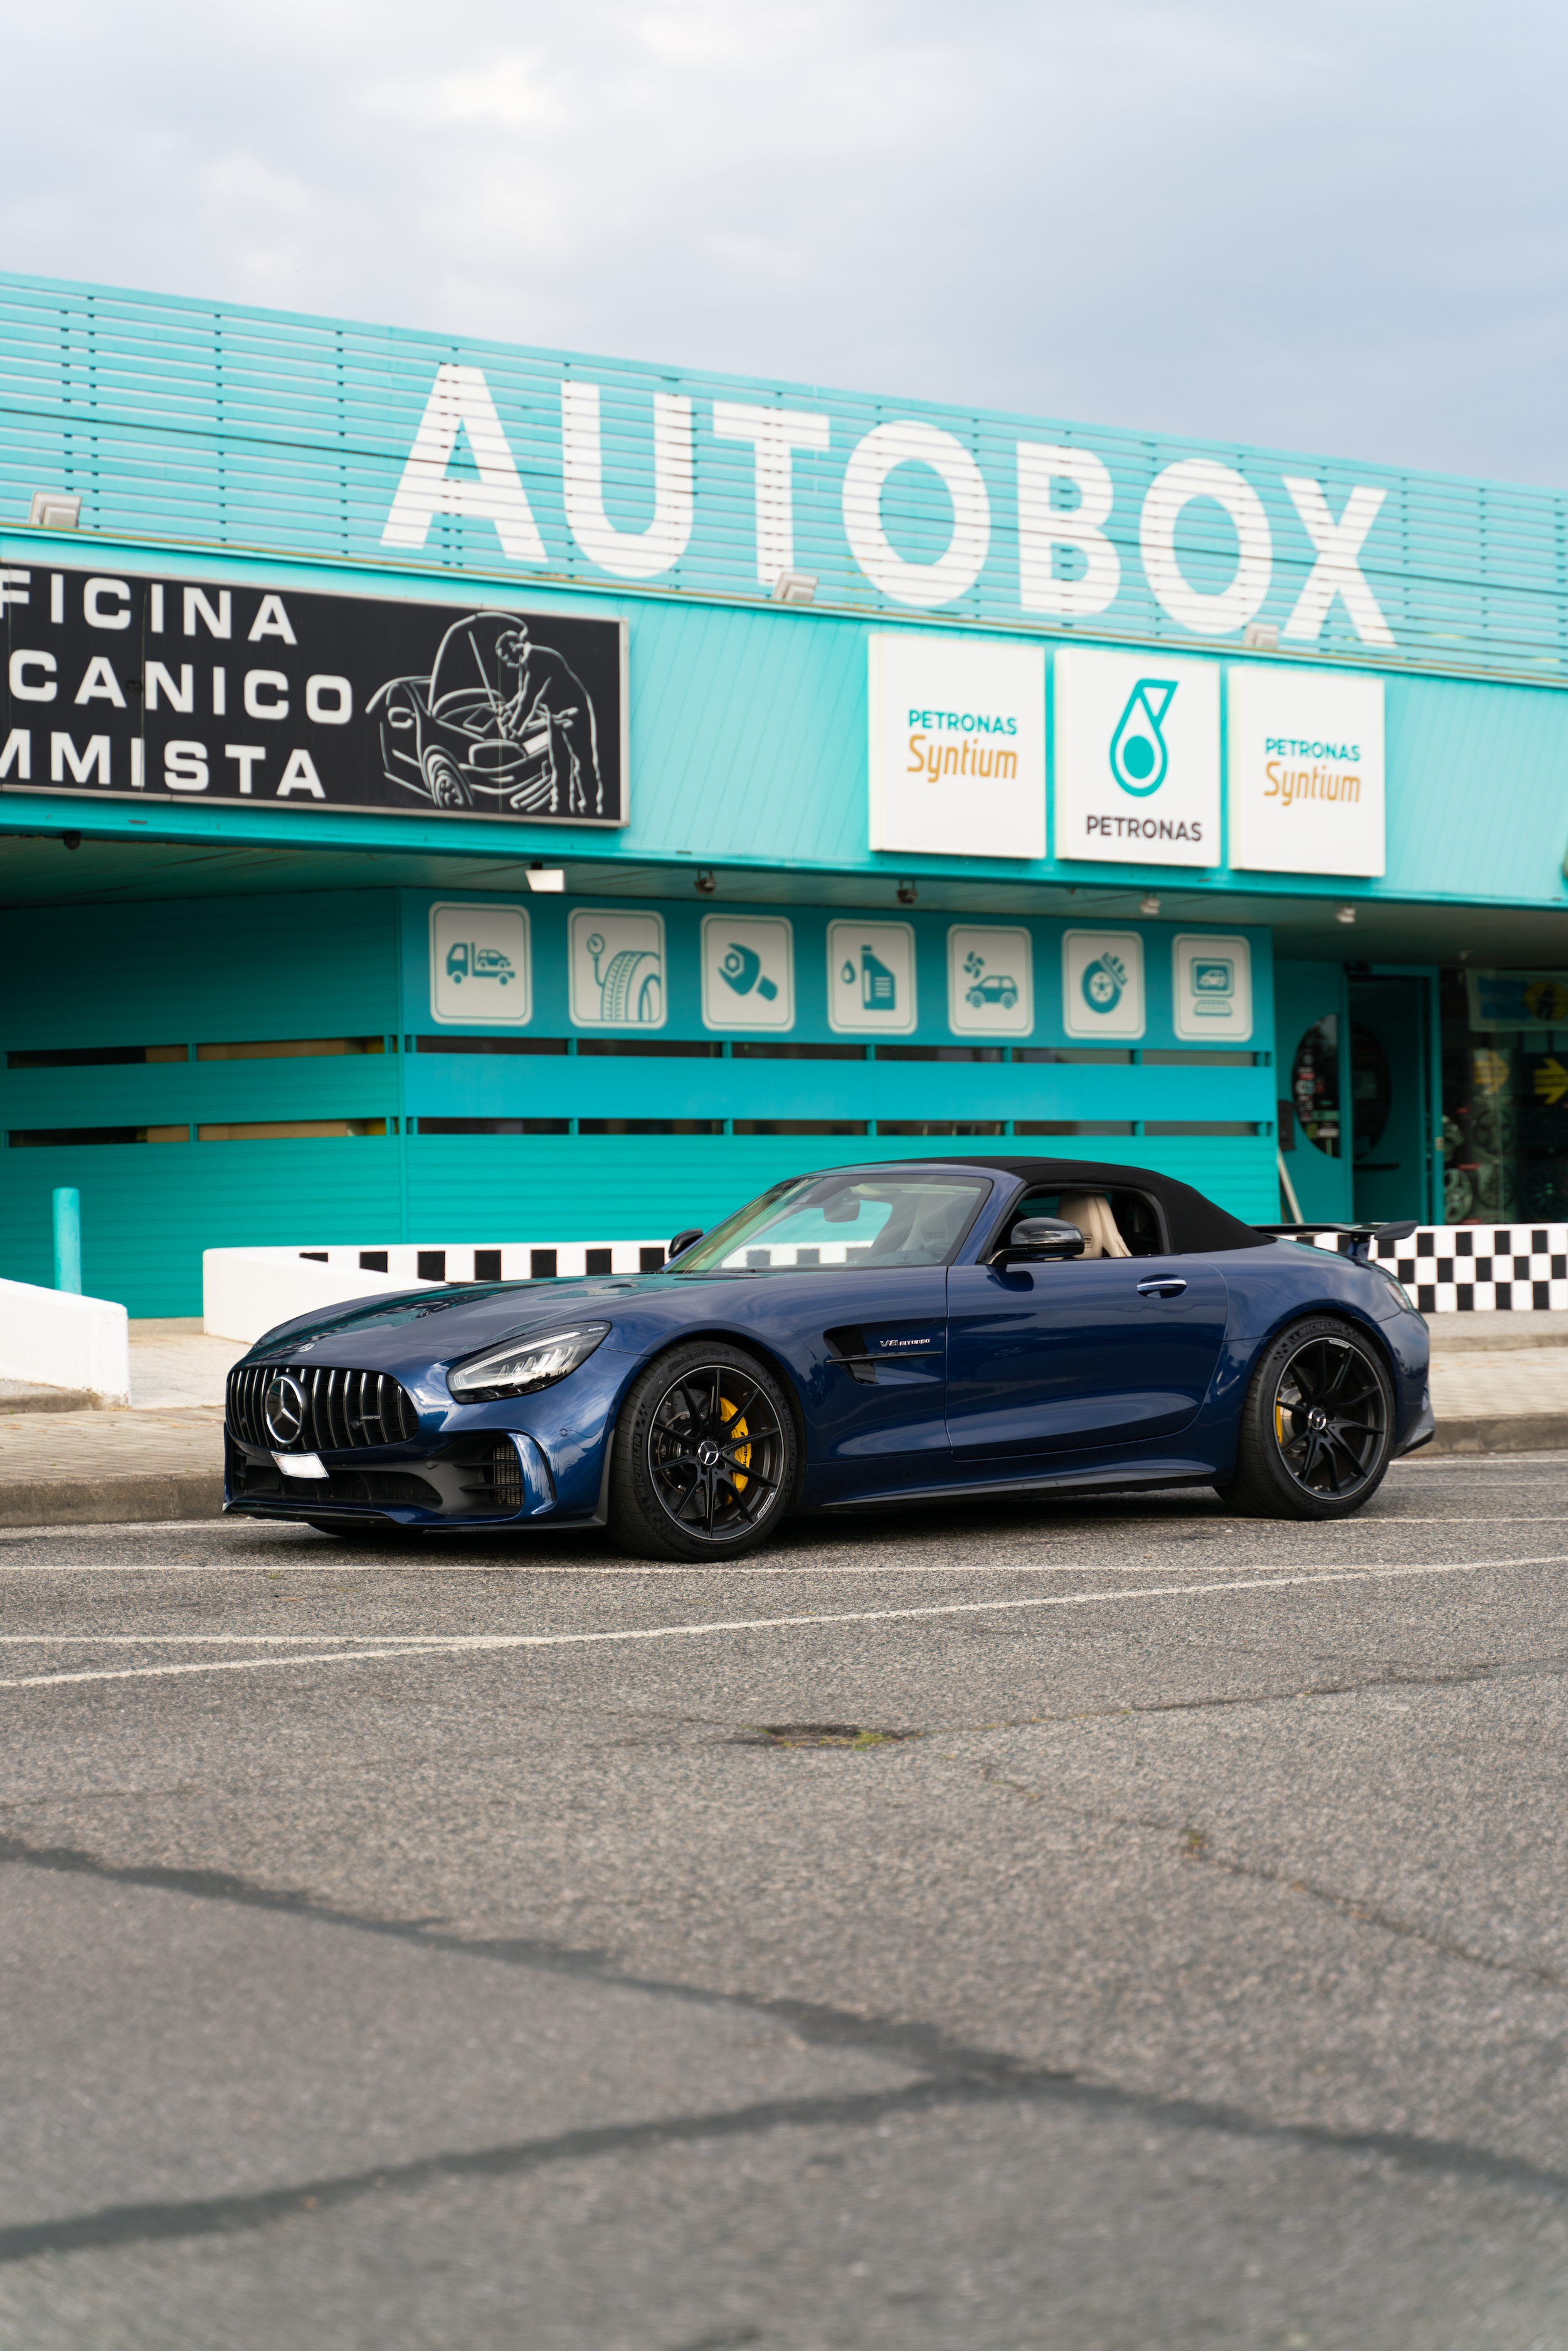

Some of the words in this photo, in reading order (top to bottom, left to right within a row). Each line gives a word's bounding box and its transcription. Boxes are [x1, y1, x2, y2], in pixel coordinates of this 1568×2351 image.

[379, 364, 1399, 647] AUTOBOX
[0, 569, 297, 645] FICINA
[9, 650, 352, 724] CANICO
[909, 709, 1017, 736] PETRONAS
[907, 735, 1017, 783] Syntium
[1266, 738, 1360, 762] PETRONAS
[1264, 762, 1360, 807] Syntium
[1086, 815, 1202, 842] PETRONAS
[880, 1339, 899, 1348] V8
[899, 1338, 931, 1347] BITURBO
[1298, 1322, 1341, 1337] MICHELIN
[667, 1357, 687, 1373] Pilot
[686, 1349, 707, 1362] Sport
[709, 1349, 723, 1357] Cup
[783, 1408, 797, 1471] MICHELIN
[633, 1433, 649, 1498] MICHELIN
